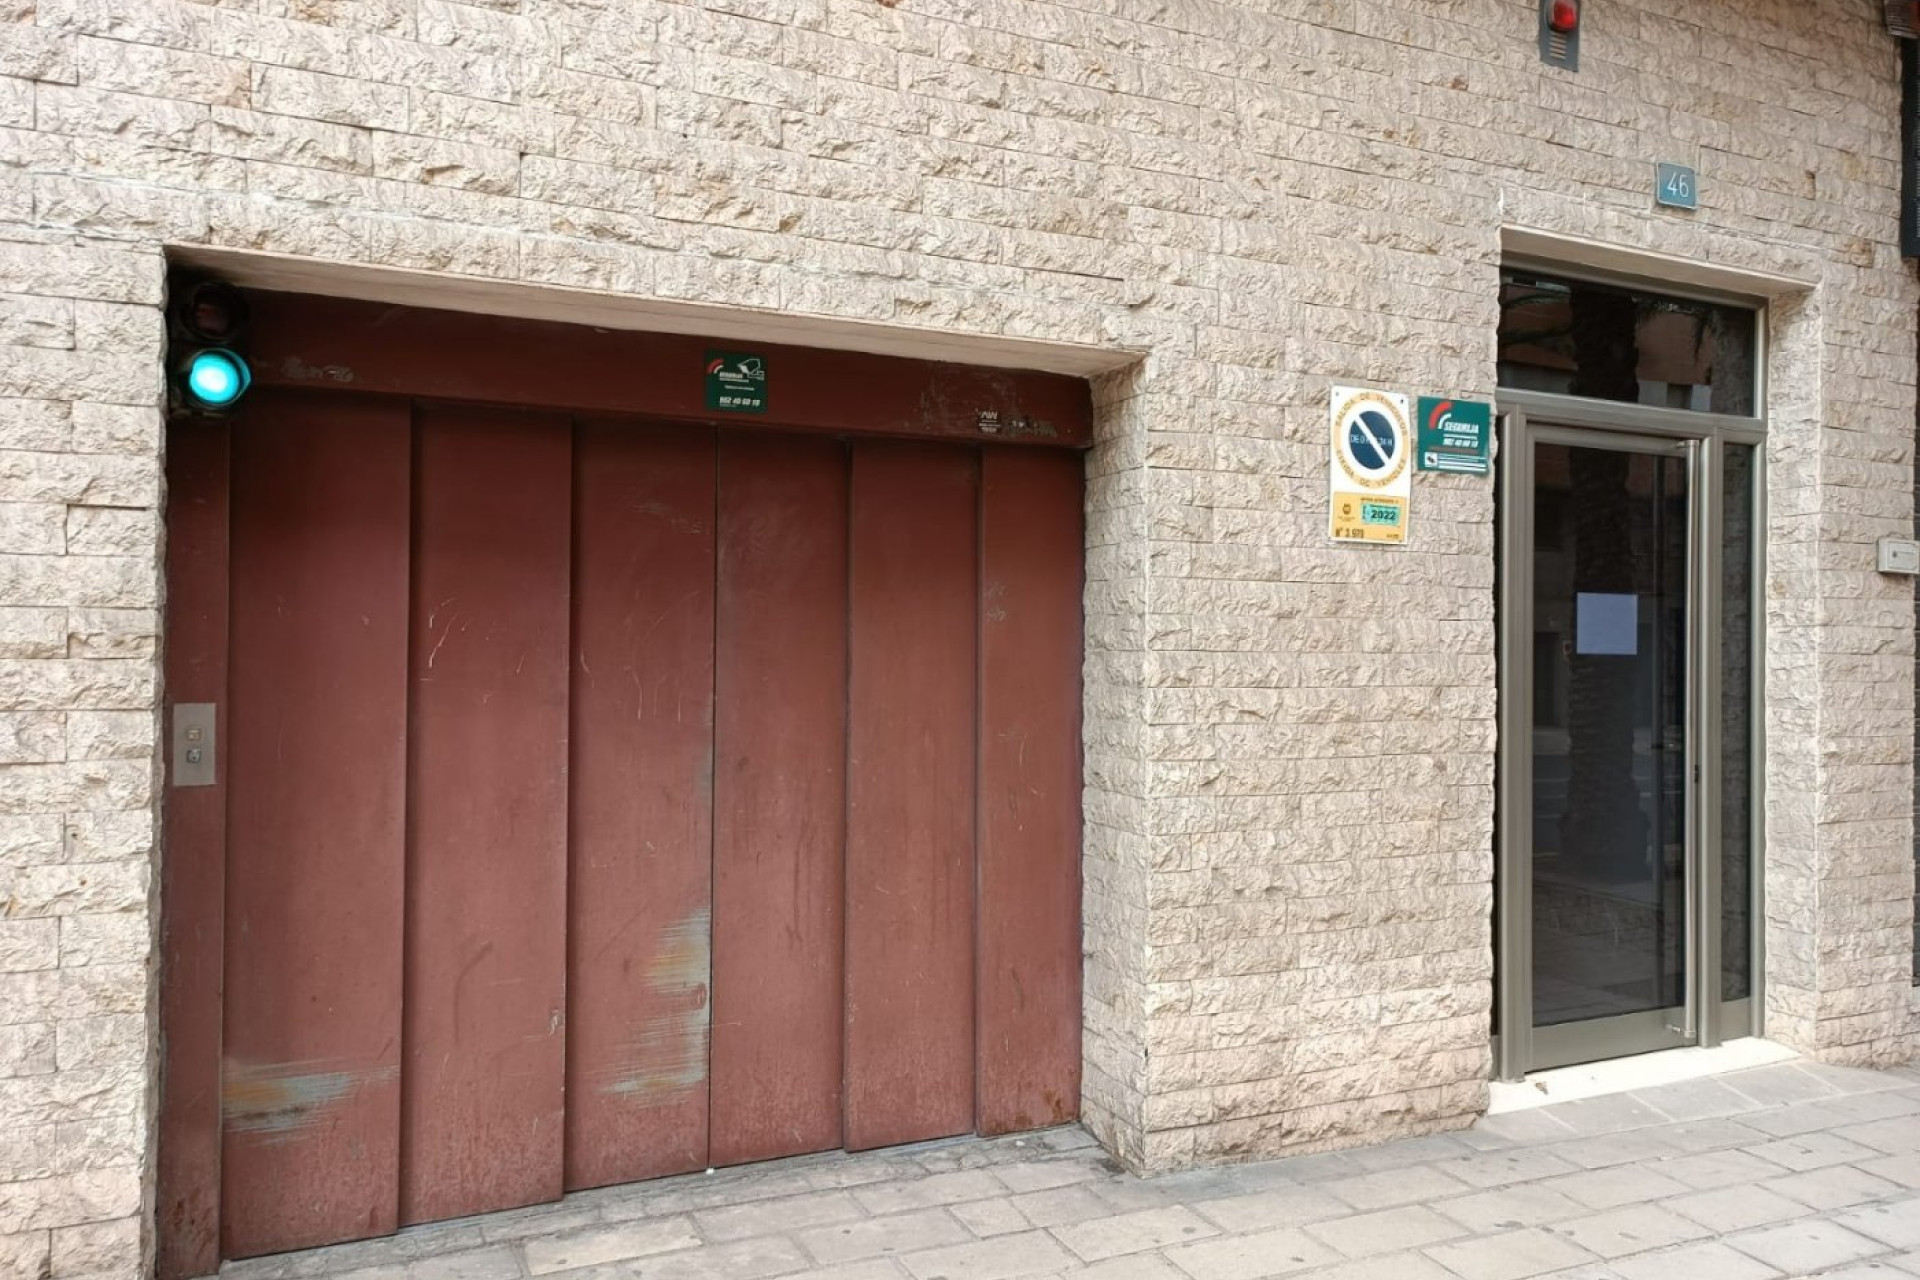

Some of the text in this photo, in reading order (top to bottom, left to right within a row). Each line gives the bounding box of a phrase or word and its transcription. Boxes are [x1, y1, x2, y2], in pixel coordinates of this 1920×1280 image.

[1667, 171, 1689, 198] 46
[1443, 421, 1479, 434] SEGURIJA
[1350, 433, 1360, 444] DE
[1370, 509, 1397, 521] 2022
